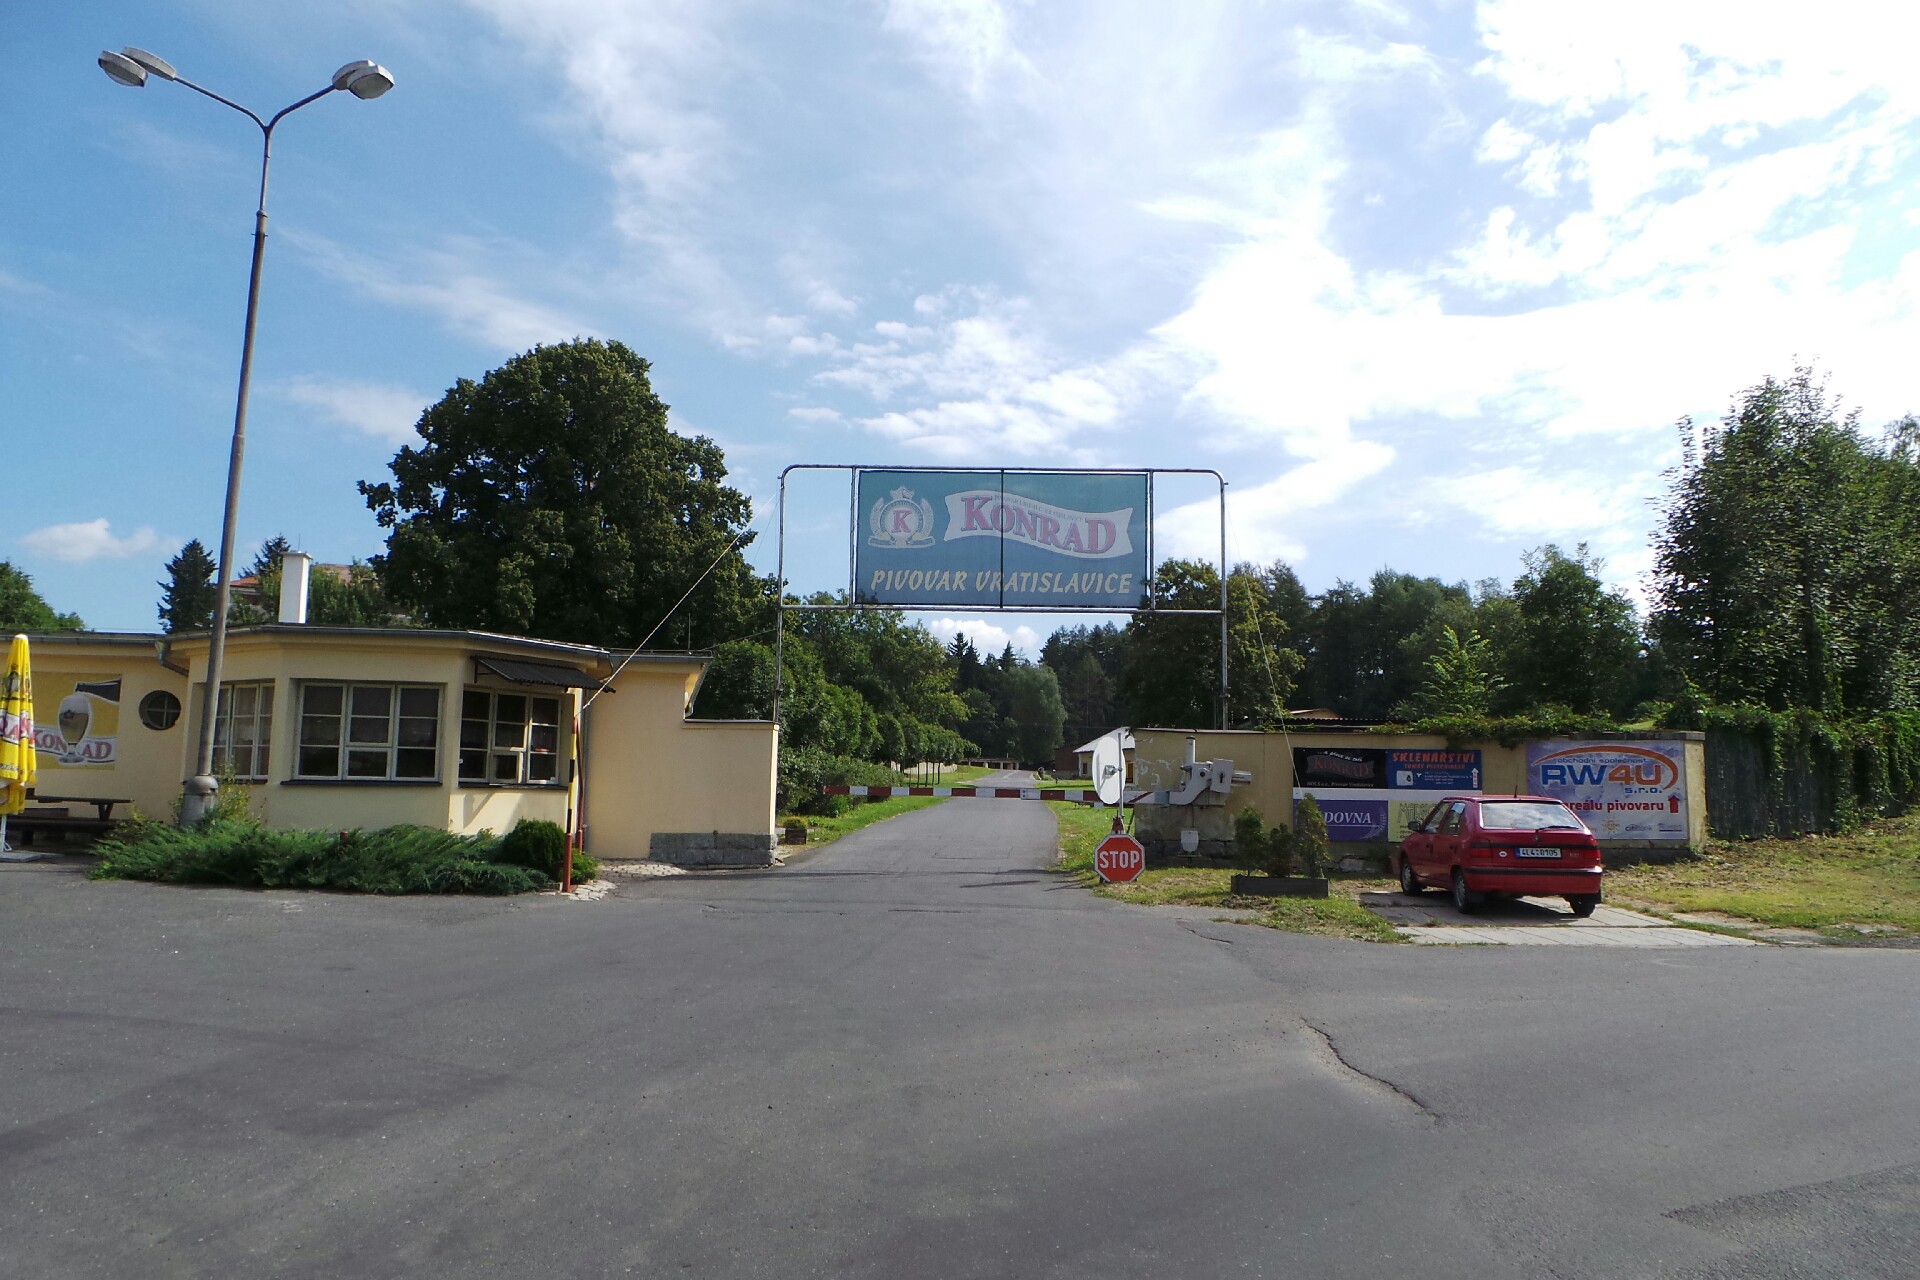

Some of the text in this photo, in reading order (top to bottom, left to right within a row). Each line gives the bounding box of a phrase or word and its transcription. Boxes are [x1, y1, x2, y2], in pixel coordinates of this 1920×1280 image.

[890, 509, 912, 533] K
[960, 495, 1117, 555] KONRAD
[870, 569, 1133, 594] PIVOVAR VRATISLAVICE
[33, 729, 112, 760] KONAD
[1541, 764, 1662, 786] RW4U
[1324, 811, 1372, 824] DOVNA
[1607, 799, 1664, 813] pivovaru
[1099, 850, 1140, 869] STOP
